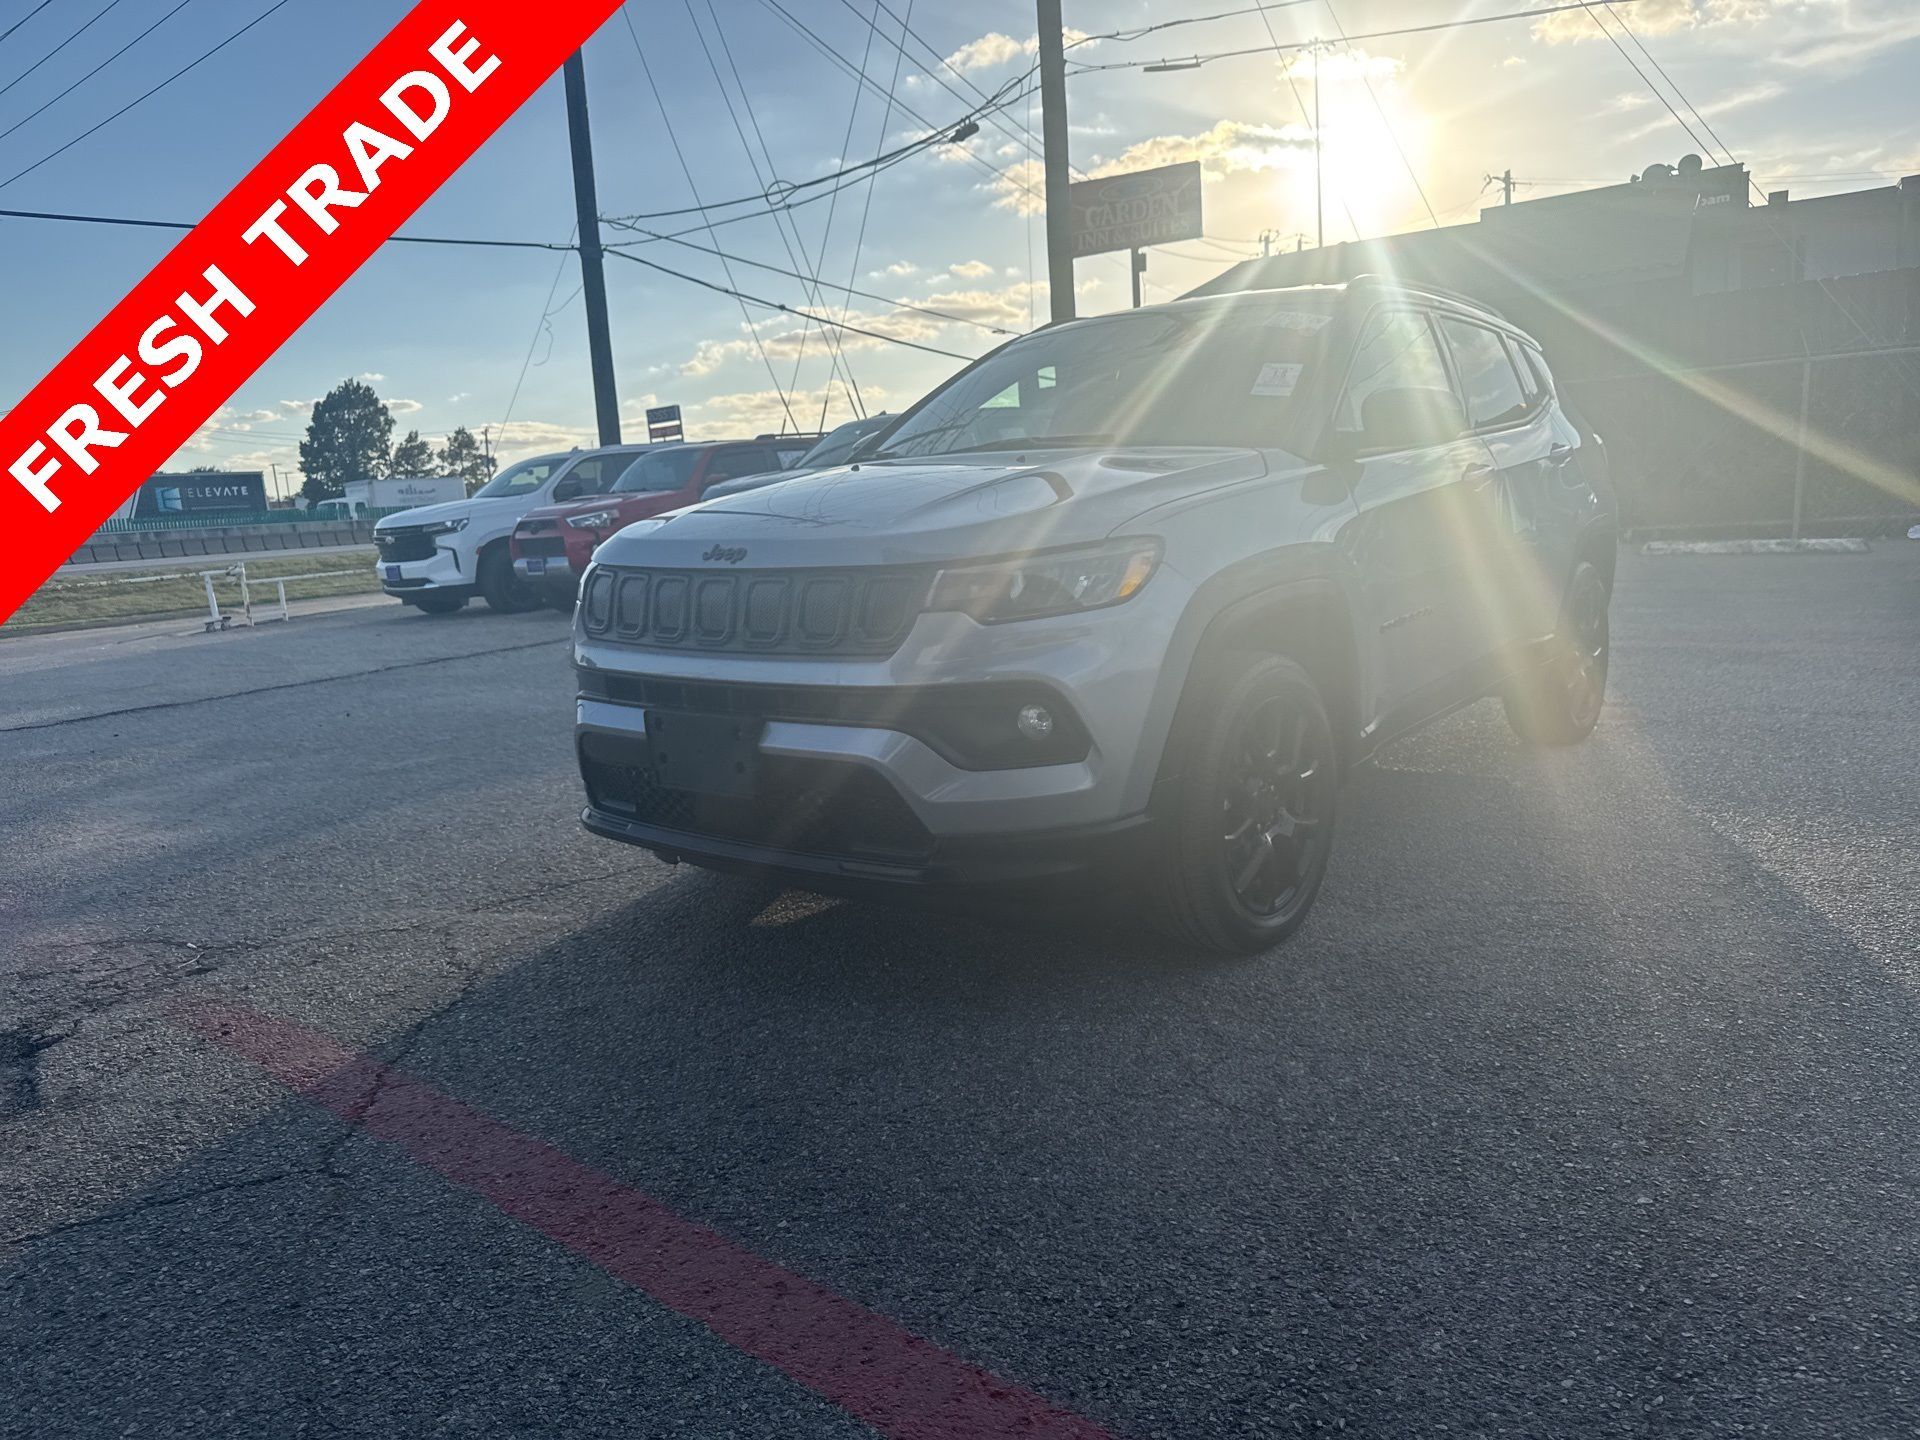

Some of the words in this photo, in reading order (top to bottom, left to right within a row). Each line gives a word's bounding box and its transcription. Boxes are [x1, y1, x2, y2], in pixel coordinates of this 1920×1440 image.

[1085, 192, 1179, 227] GARDEN
[1078, 230, 1109, 250] INN
[1131, 217, 1190, 241] SUITES
[187, 486, 248, 498] ELEVATE
[702, 543, 748, 565] Jeep
